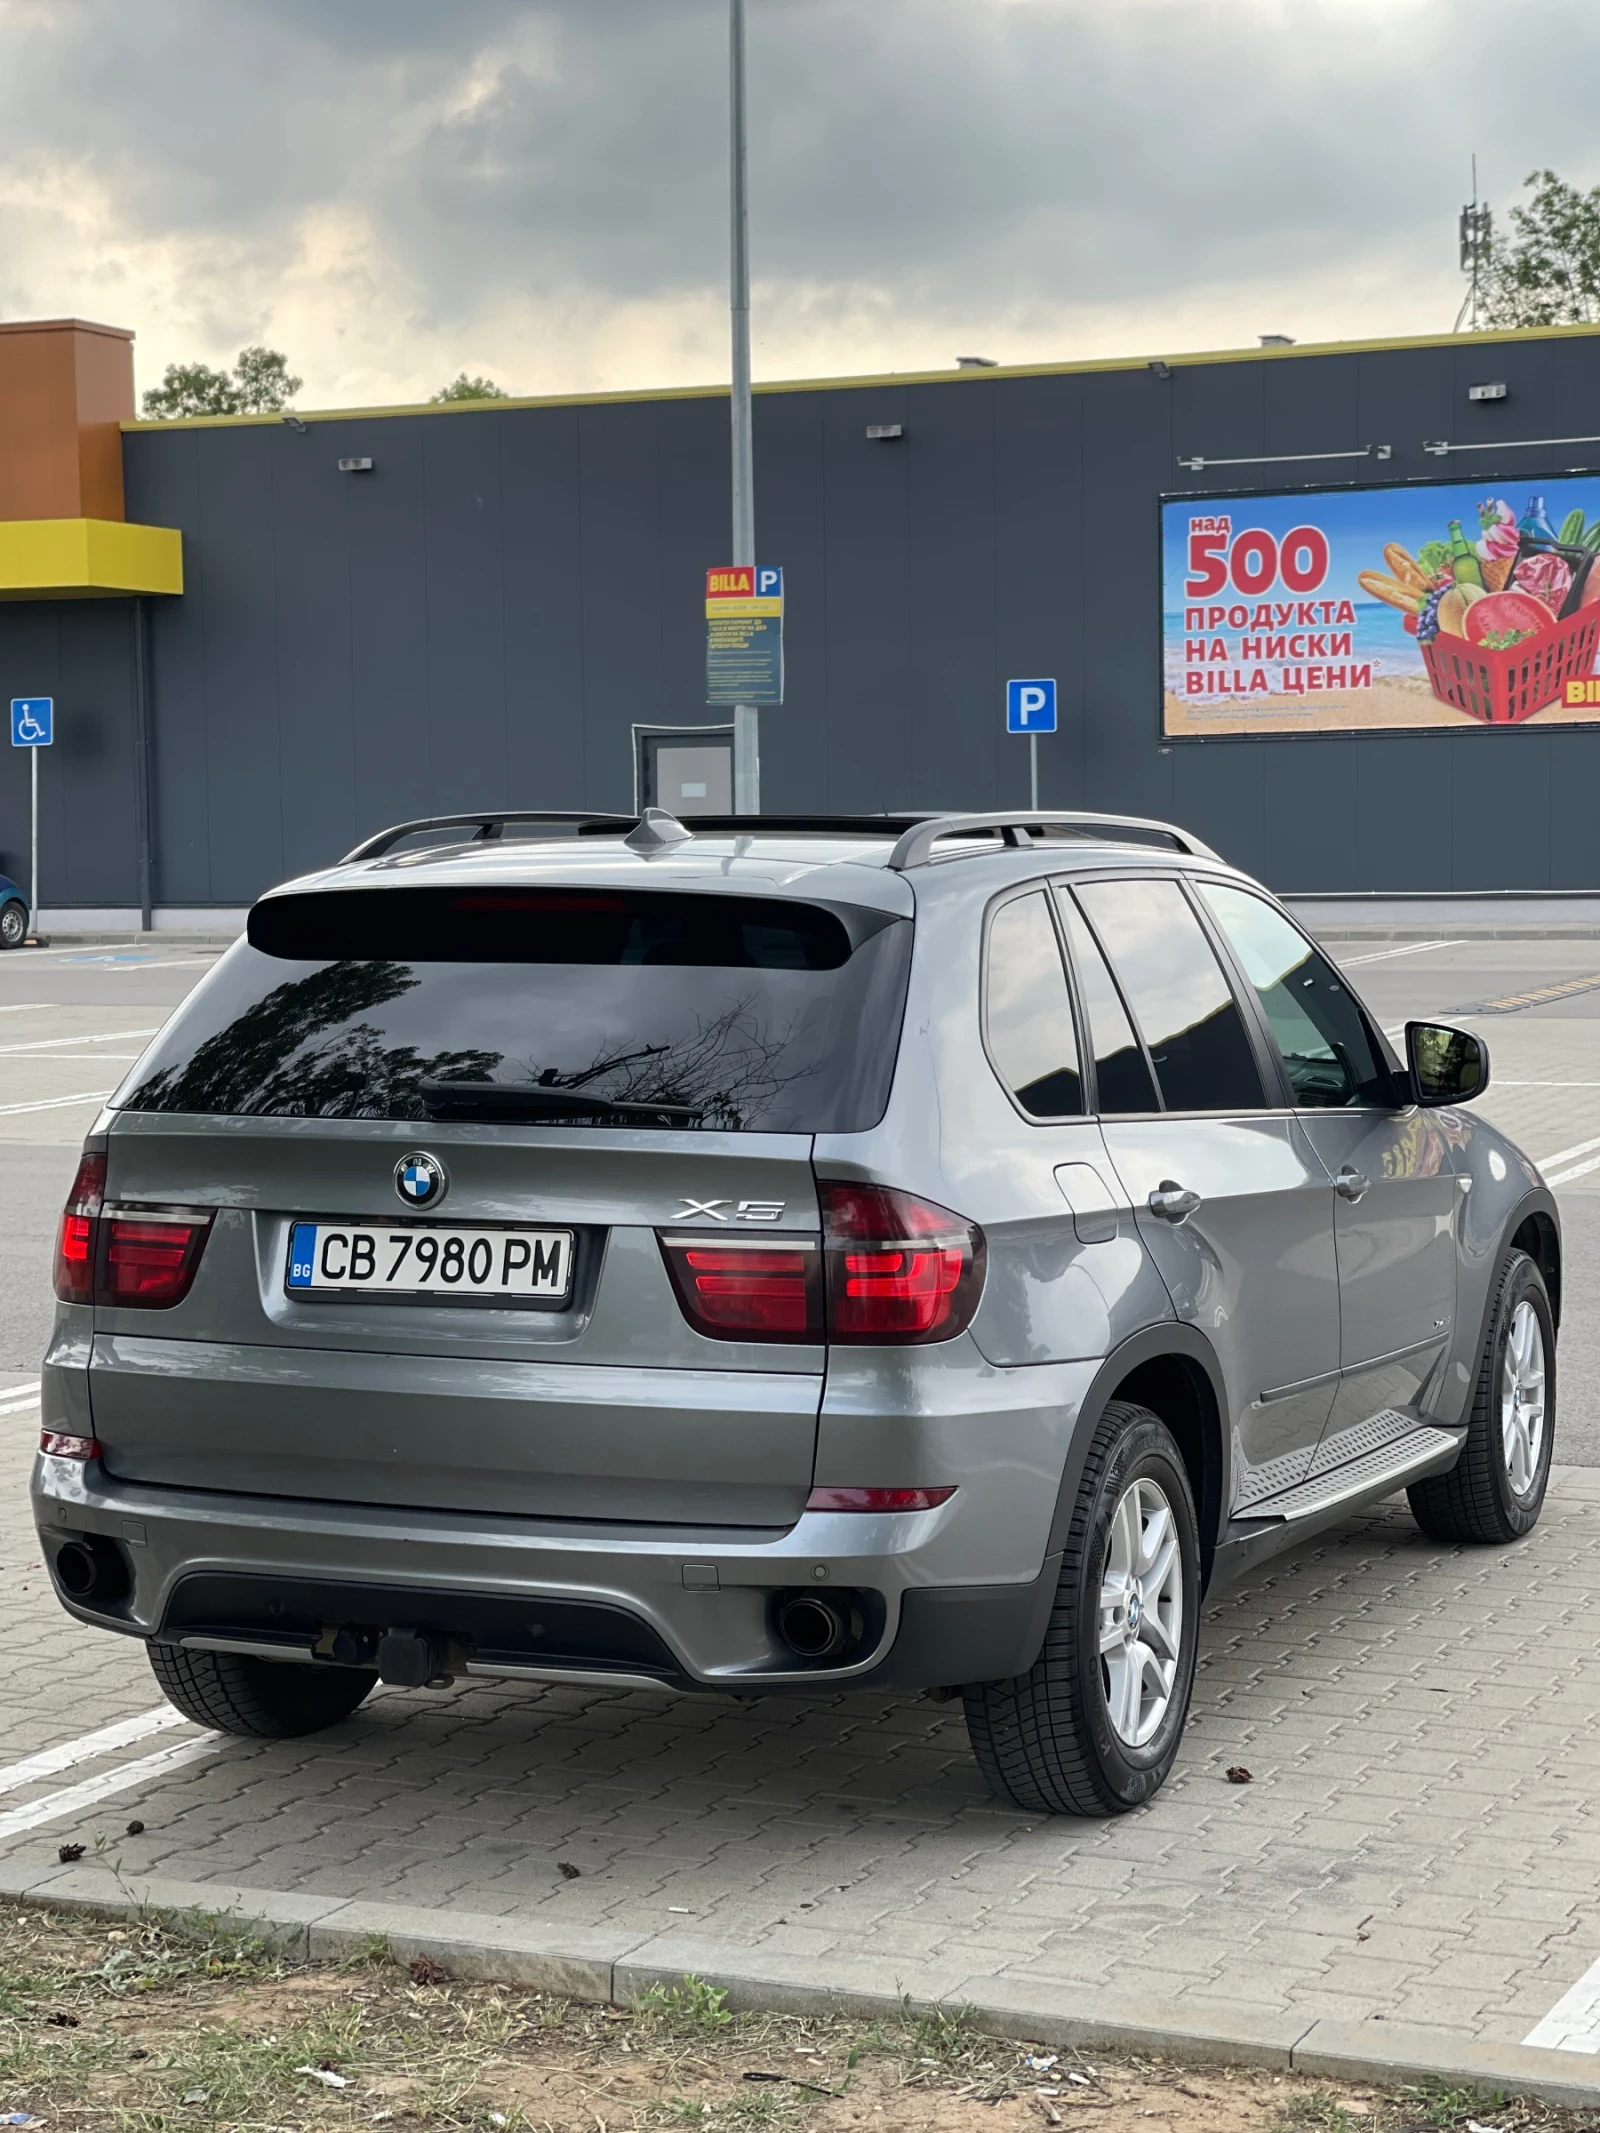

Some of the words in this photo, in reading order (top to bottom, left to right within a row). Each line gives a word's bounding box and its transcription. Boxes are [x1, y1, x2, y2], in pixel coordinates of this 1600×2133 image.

[1190, 517, 1231, 534] над
[1185, 526, 1329, 598] 500
[709, 573, 750, 592] BILLA
[760, 570, 778, 593] P
[1185, 600, 1356, 633] ПРОДУКТА
[1185, 638, 1228, 663] НА
[1241, 632, 1352, 660] НИСКИ
[1186, 668, 1269, 695] BILLA
[1020, 687, 1046, 725] P
[400, 1158, 436, 1174] BMW
[669, 1198, 786, 1222] X5
[292, 1263, 311, 1278] BG
[320, 1233, 376, 1280] CB
[385, 1235, 493, 1285] 7980
[501, 1238, 562, 1287] PM
